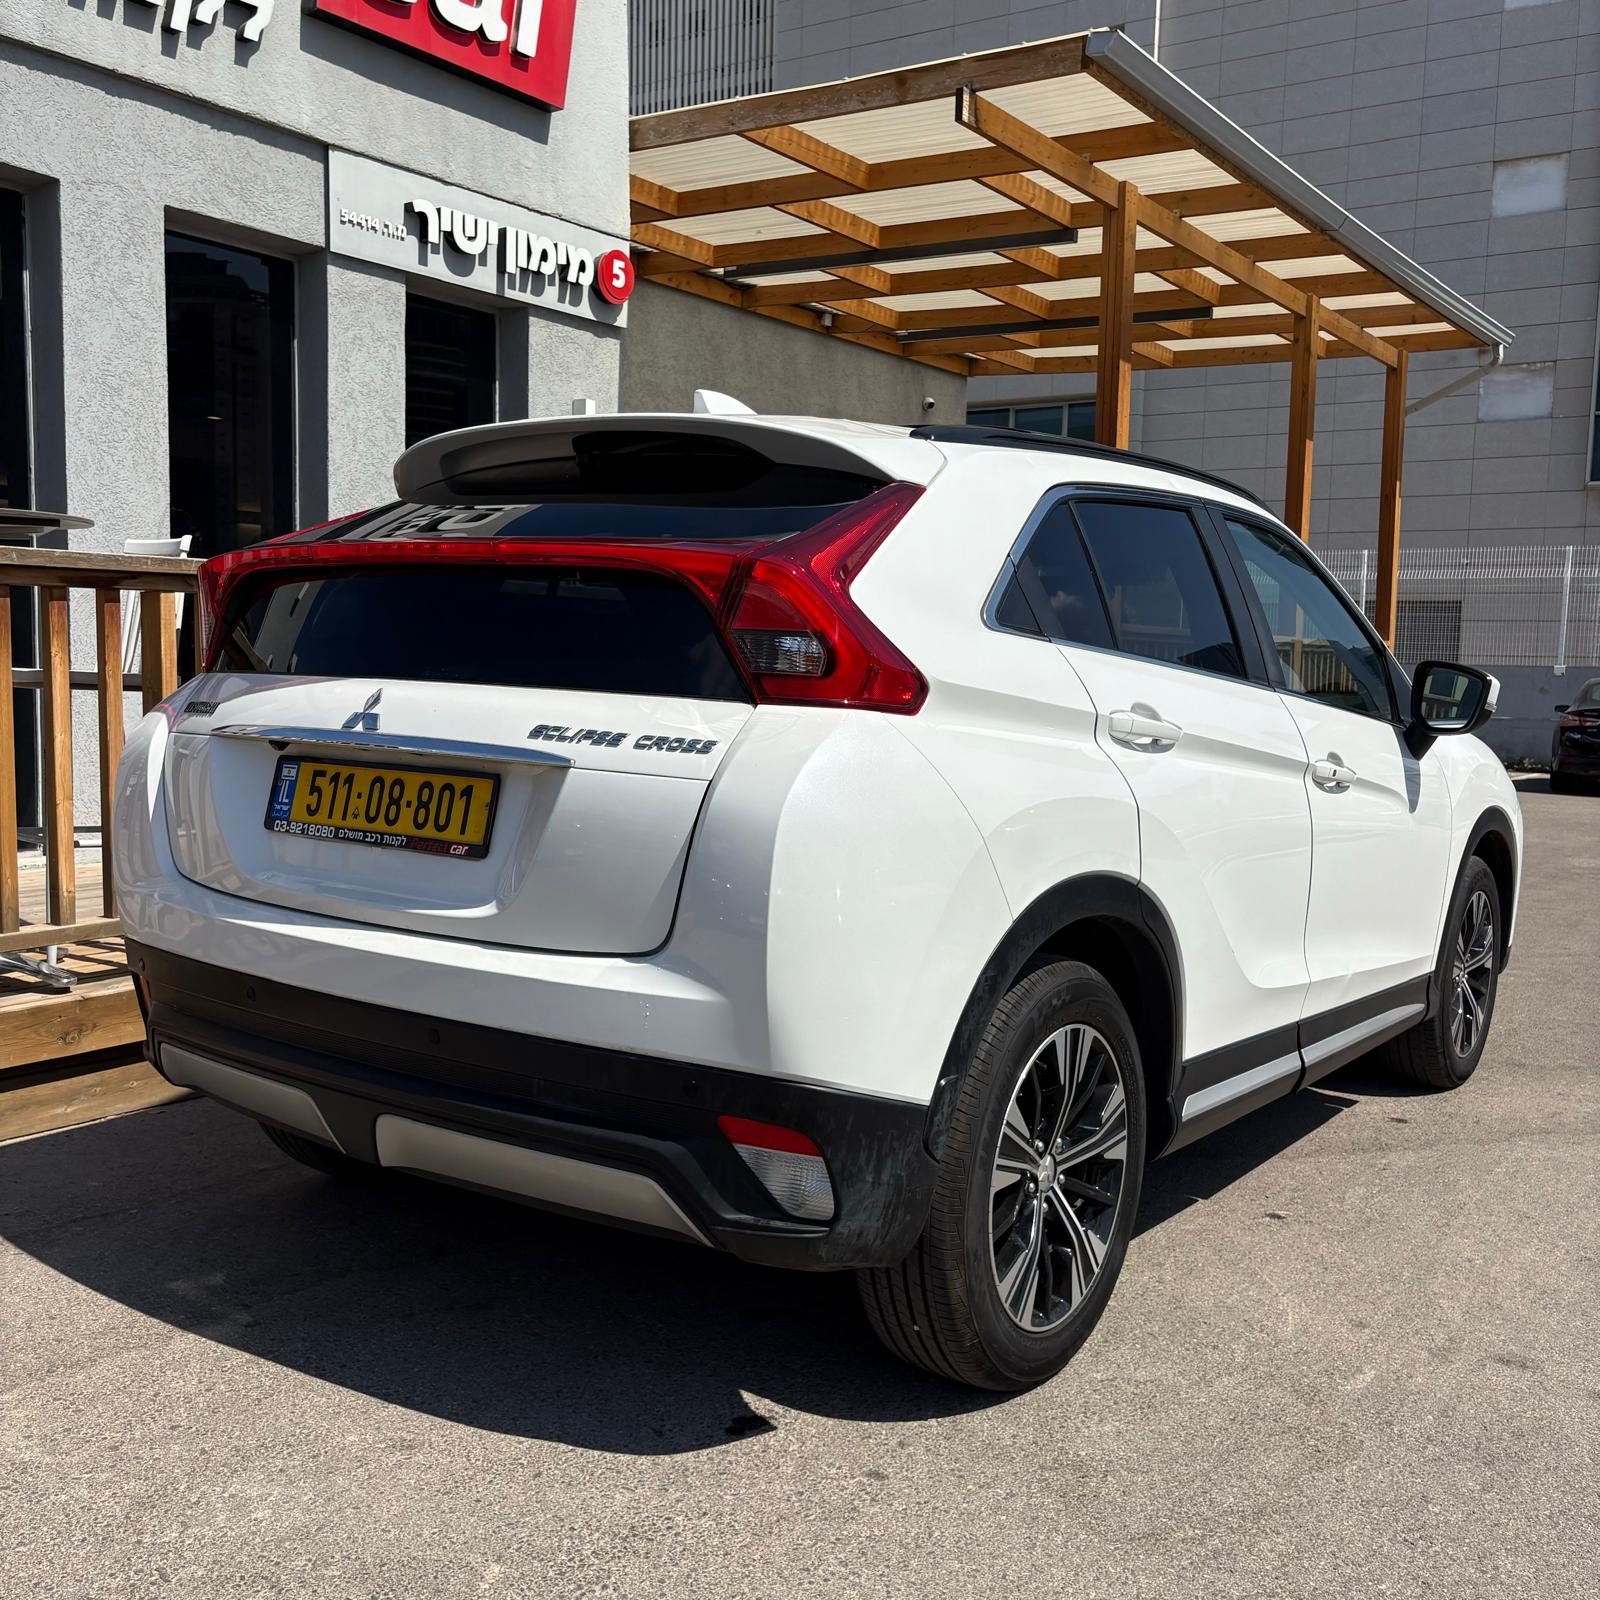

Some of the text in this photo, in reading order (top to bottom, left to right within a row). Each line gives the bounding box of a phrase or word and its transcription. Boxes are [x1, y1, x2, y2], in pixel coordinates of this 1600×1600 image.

[340, 208, 381, 231] 54414
[410, 199, 626, 289] 5 מימון ישיר
[527, 724, 720, 755] ECLIPSE CROSS
[278, 780, 290, 803] IL
[338, 828, 407, 847] לקנות רכב מושלם
[449, 844, 470, 855] car
